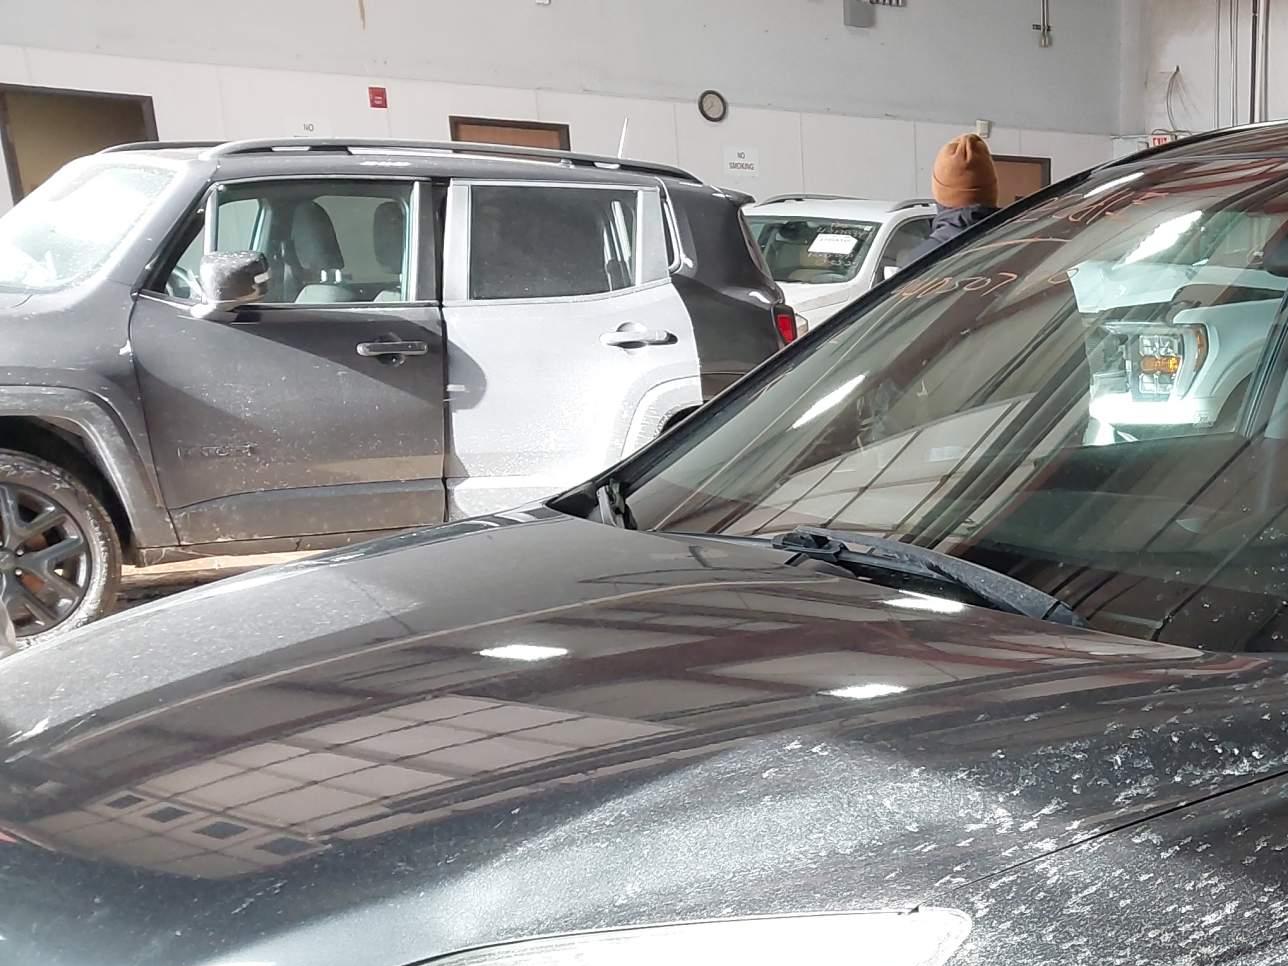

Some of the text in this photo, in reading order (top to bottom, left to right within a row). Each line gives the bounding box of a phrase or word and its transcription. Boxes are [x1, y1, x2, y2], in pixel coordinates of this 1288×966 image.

[303, 123, 314, 132] NO
[737, 151, 746, 160] NO
[729, 162, 755, 170] SMOKING
